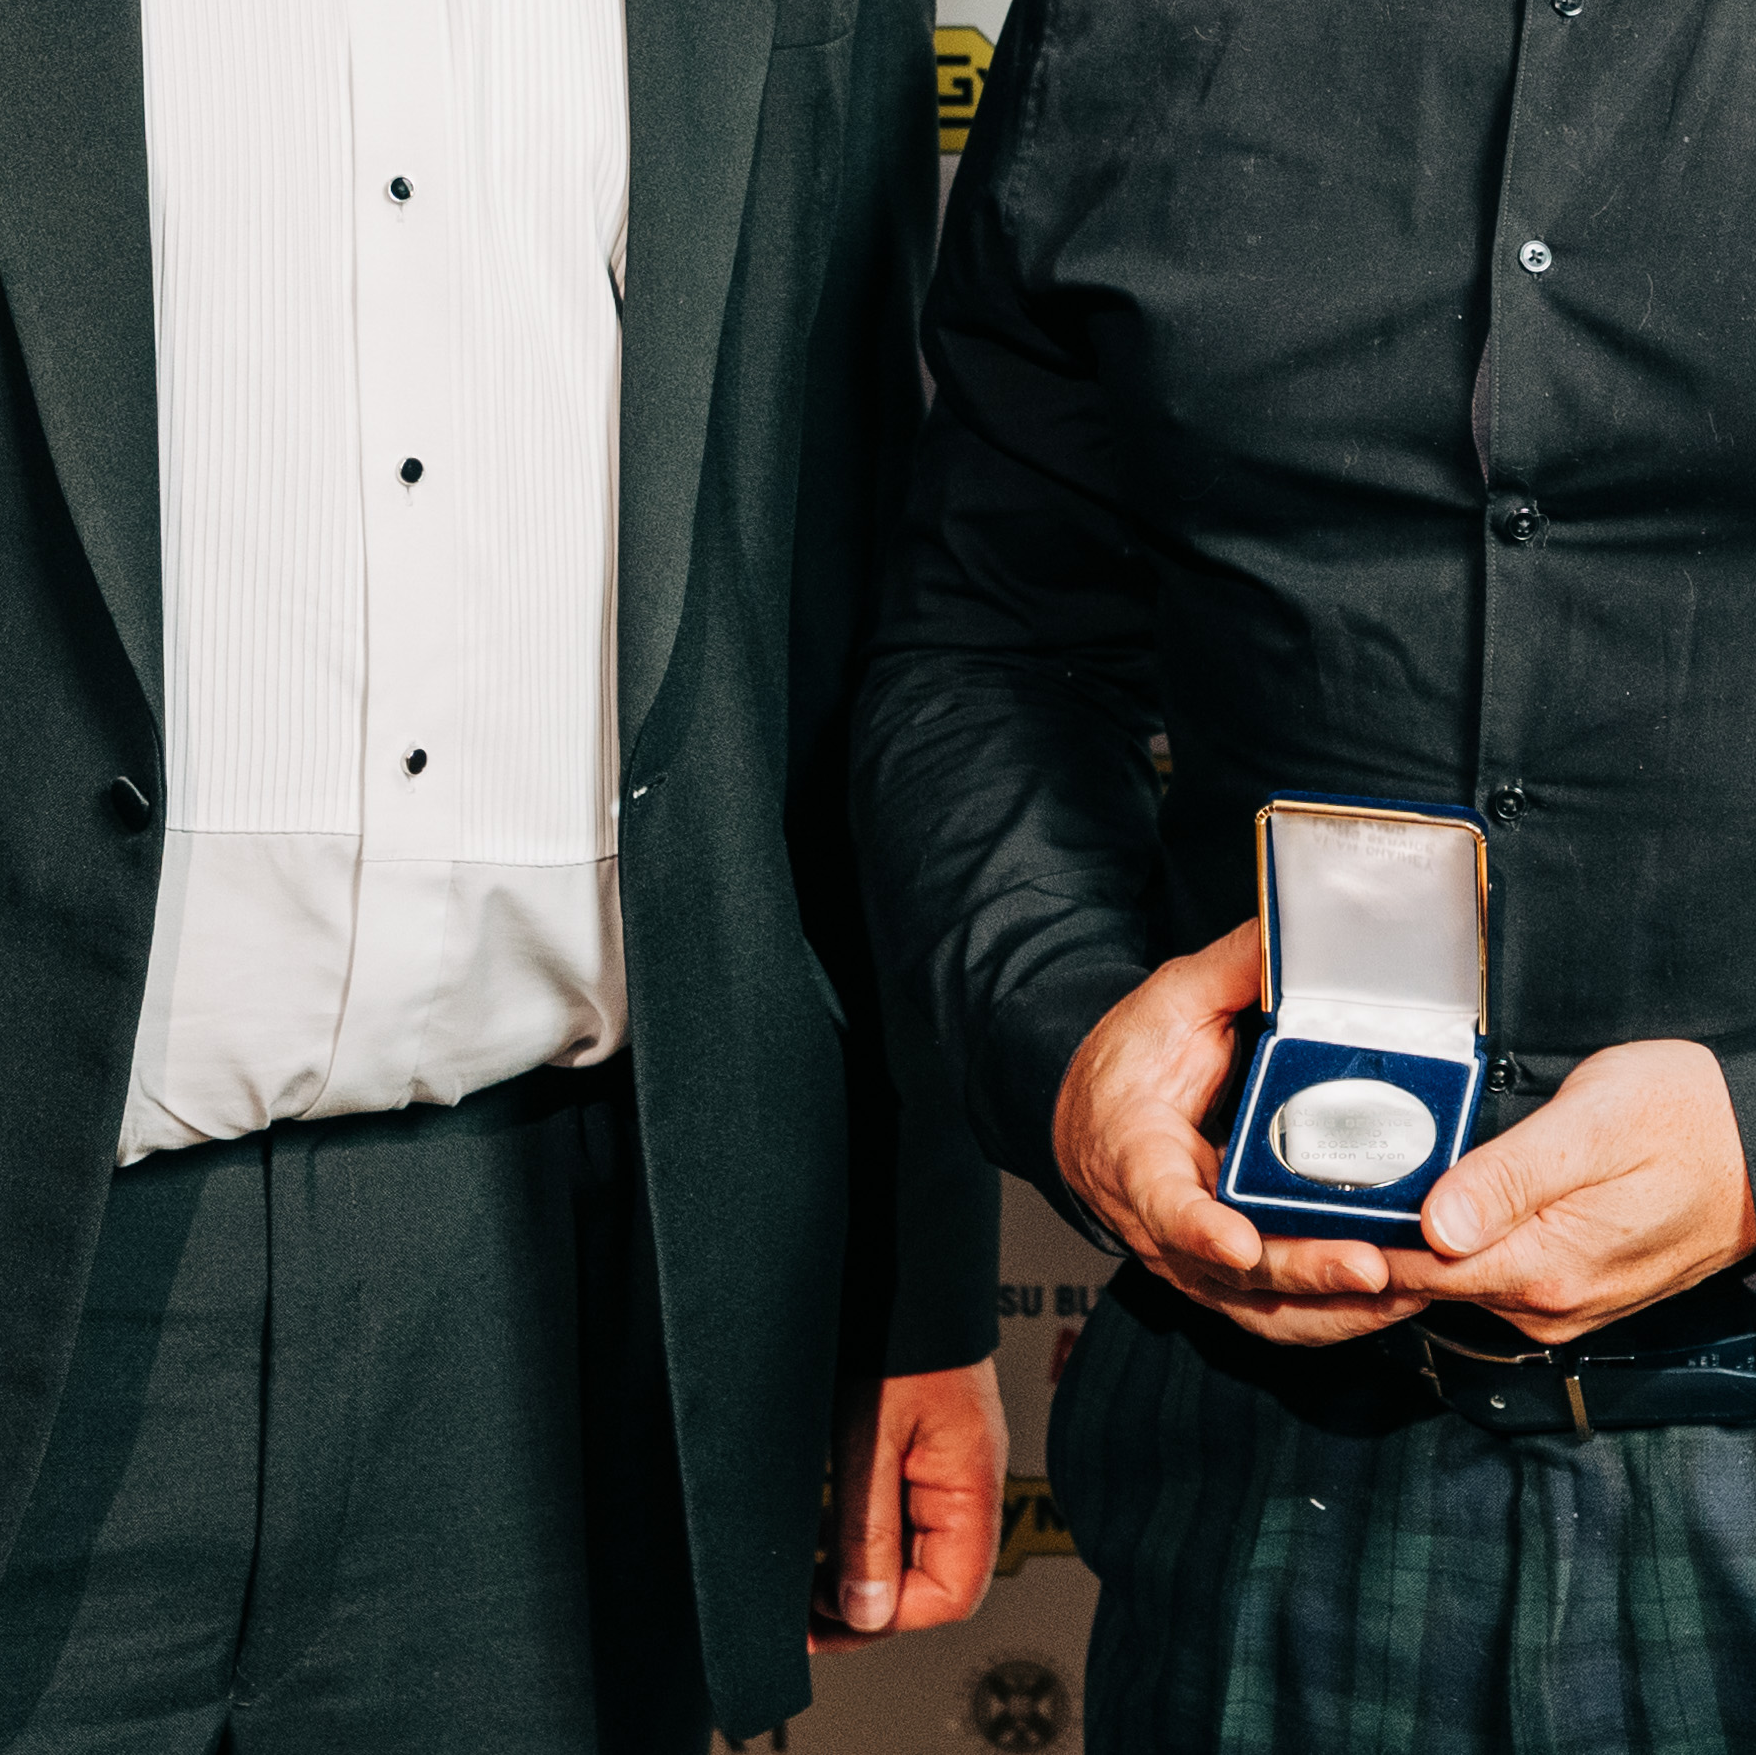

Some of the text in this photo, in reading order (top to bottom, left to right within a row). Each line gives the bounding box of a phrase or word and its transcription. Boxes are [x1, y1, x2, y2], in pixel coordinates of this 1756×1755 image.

[1317, 1140, 1389, 1149] 2022-23
[1300, 1151, 1405, 1161] Gordon Lyon
